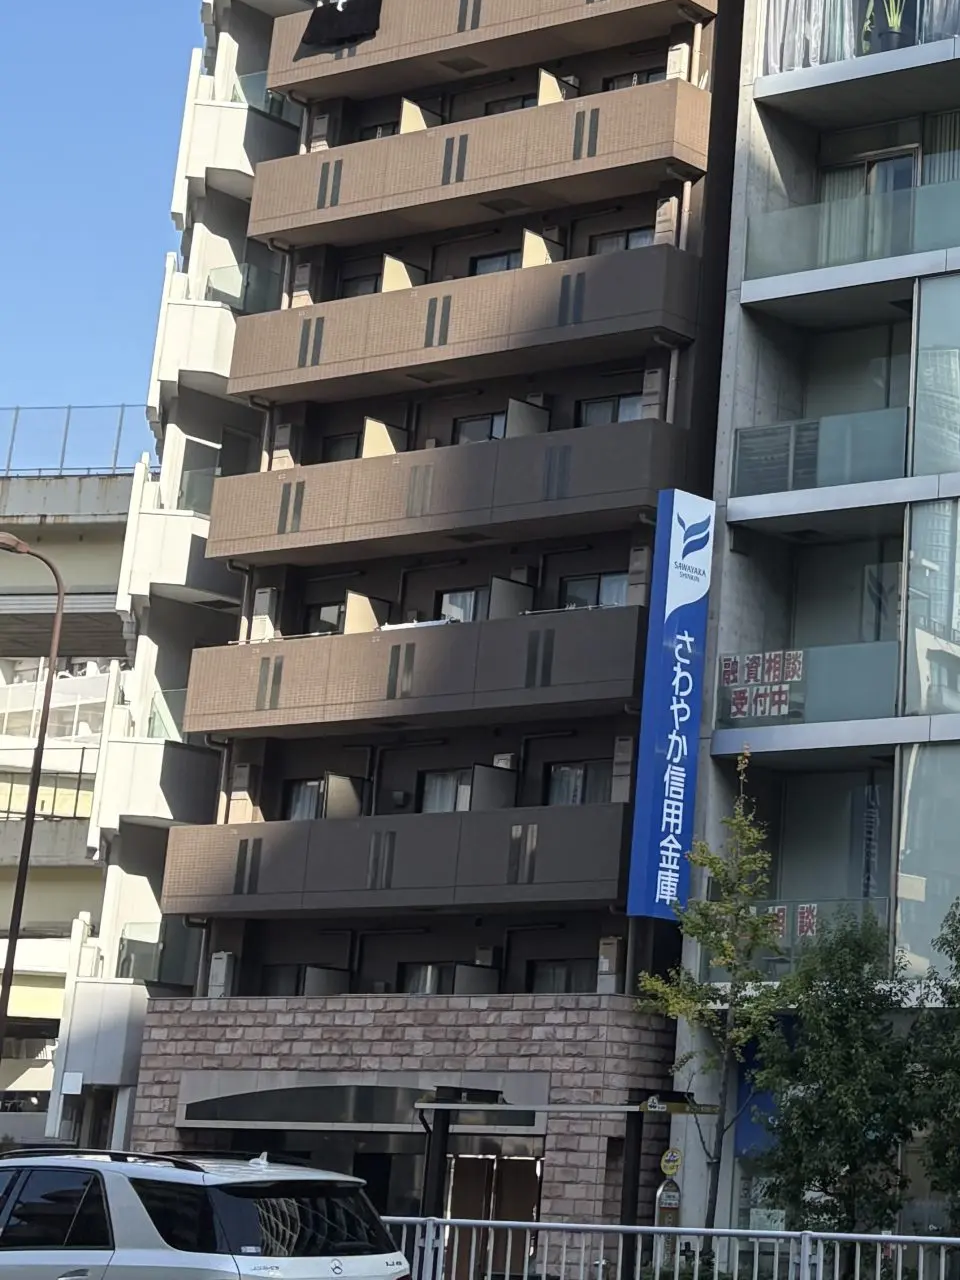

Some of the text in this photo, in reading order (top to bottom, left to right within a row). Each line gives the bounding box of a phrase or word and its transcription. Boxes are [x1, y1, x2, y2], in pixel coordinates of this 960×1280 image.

[674, 561, 707, 577] SAWAYAKA
[731, 684, 788, 716] 受付中
[655, 630, 695, 905] さわやか信用金庫
